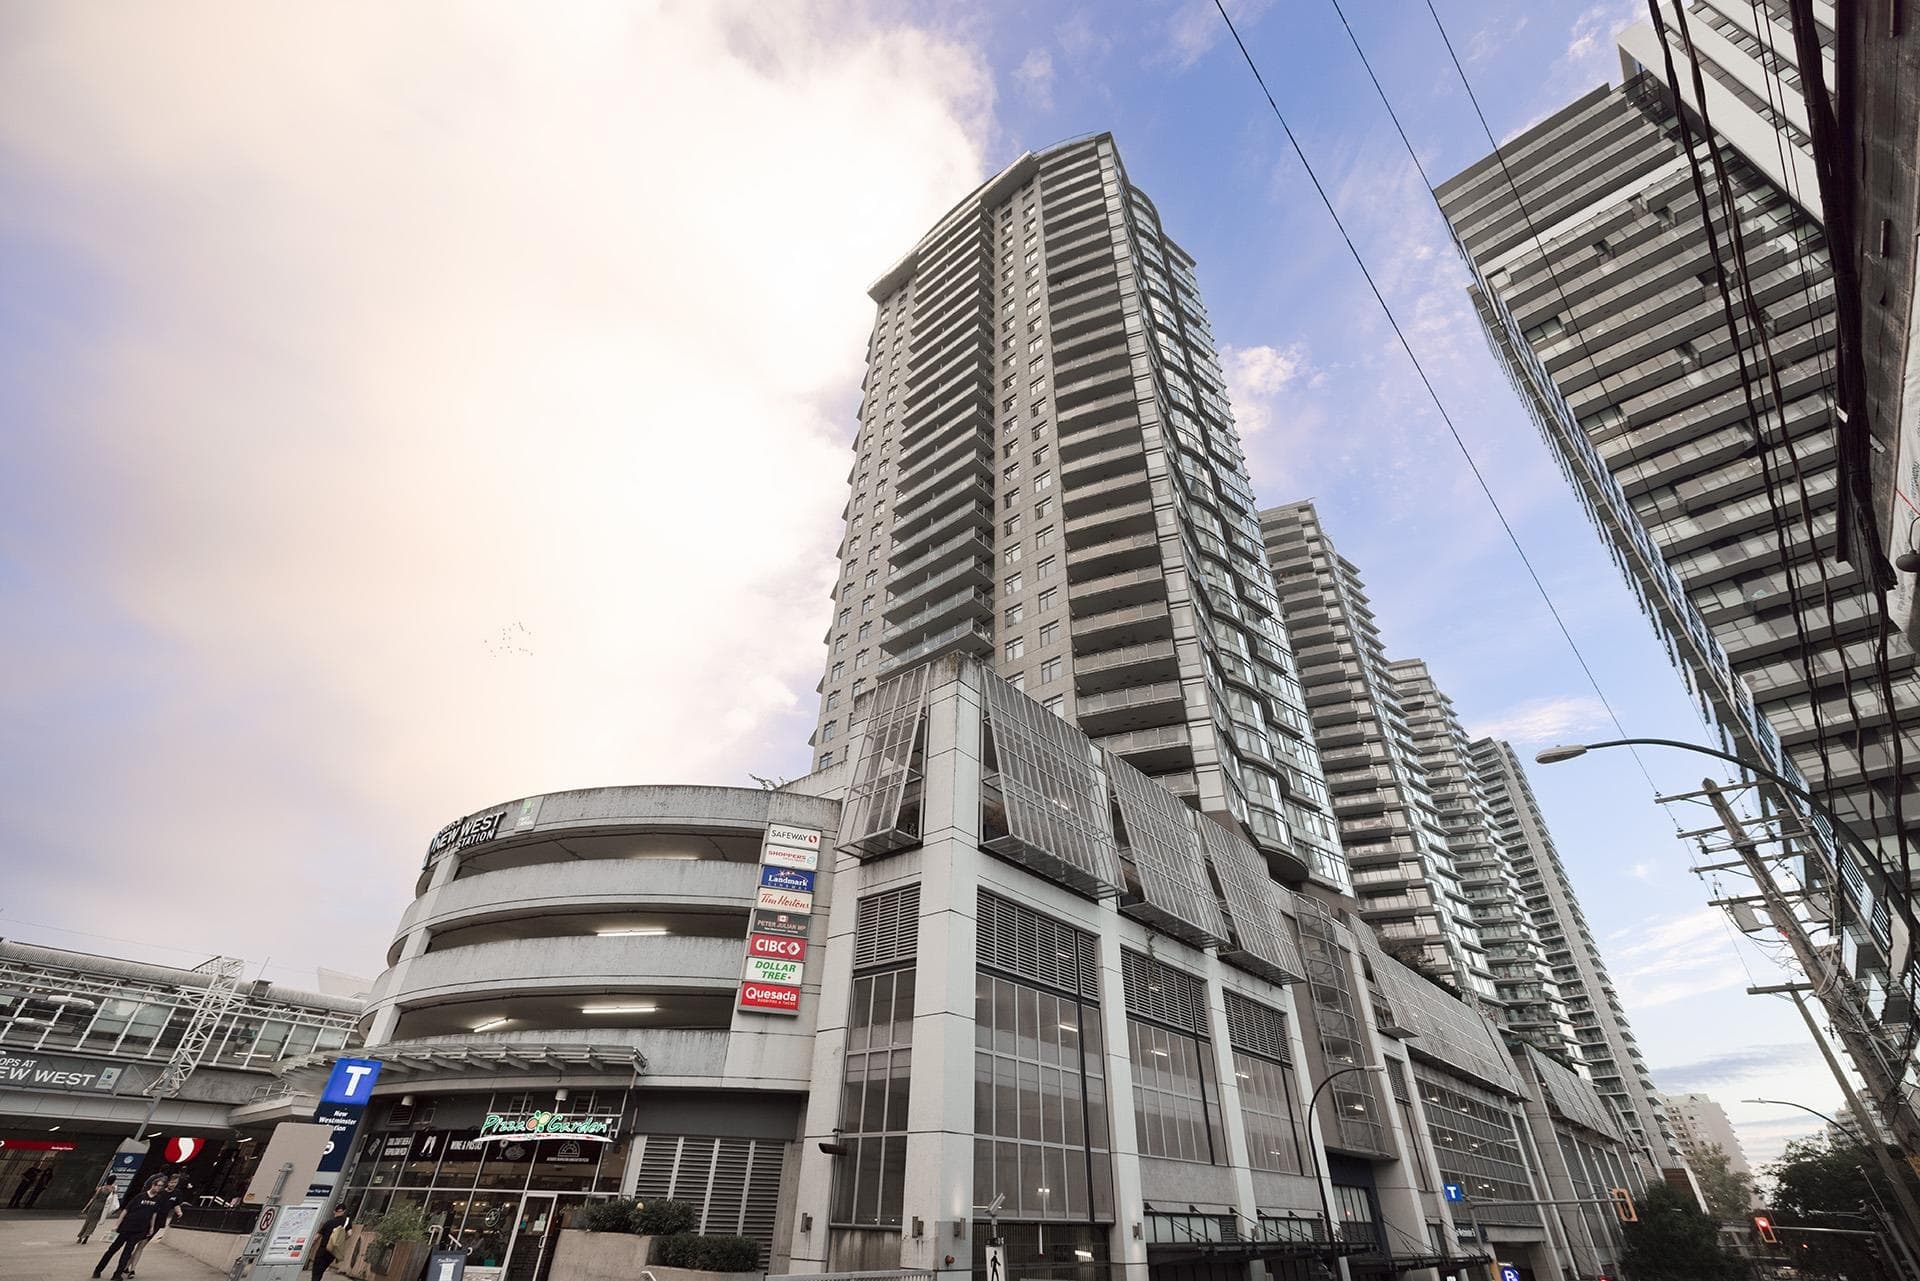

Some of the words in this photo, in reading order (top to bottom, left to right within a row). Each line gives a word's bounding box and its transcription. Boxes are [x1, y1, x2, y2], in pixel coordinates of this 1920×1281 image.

[461, 812, 506, 837] WEST
[456, 829, 495, 849] STATION
[771, 829, 808, 841] SAFEWAY
[768, 850, 806, 860] SHOPPERS
[768, 874, 808, 886] Landmark
[761, 893, 776, 904] Tim
[777, 896, 809, 909] Hortons
[756, 939, 787, 953] CIBC
[755, 961, 796, 972] DOLLAR
[762, 971, 787, 980] TREE
[745, 986, 797, 1002] Quesada
[21, 1059, 37, 1068] AT
[34, 1069, 96, 1086] WEST
[344, 1065, 372, 1097] T
[318, 1116, 357, 1126] Westminster
[546, 1114, 608, 1134] Garden
[1446, 1186, 1456, 1199] T
[1503, 1270, 1516, 1281] P
